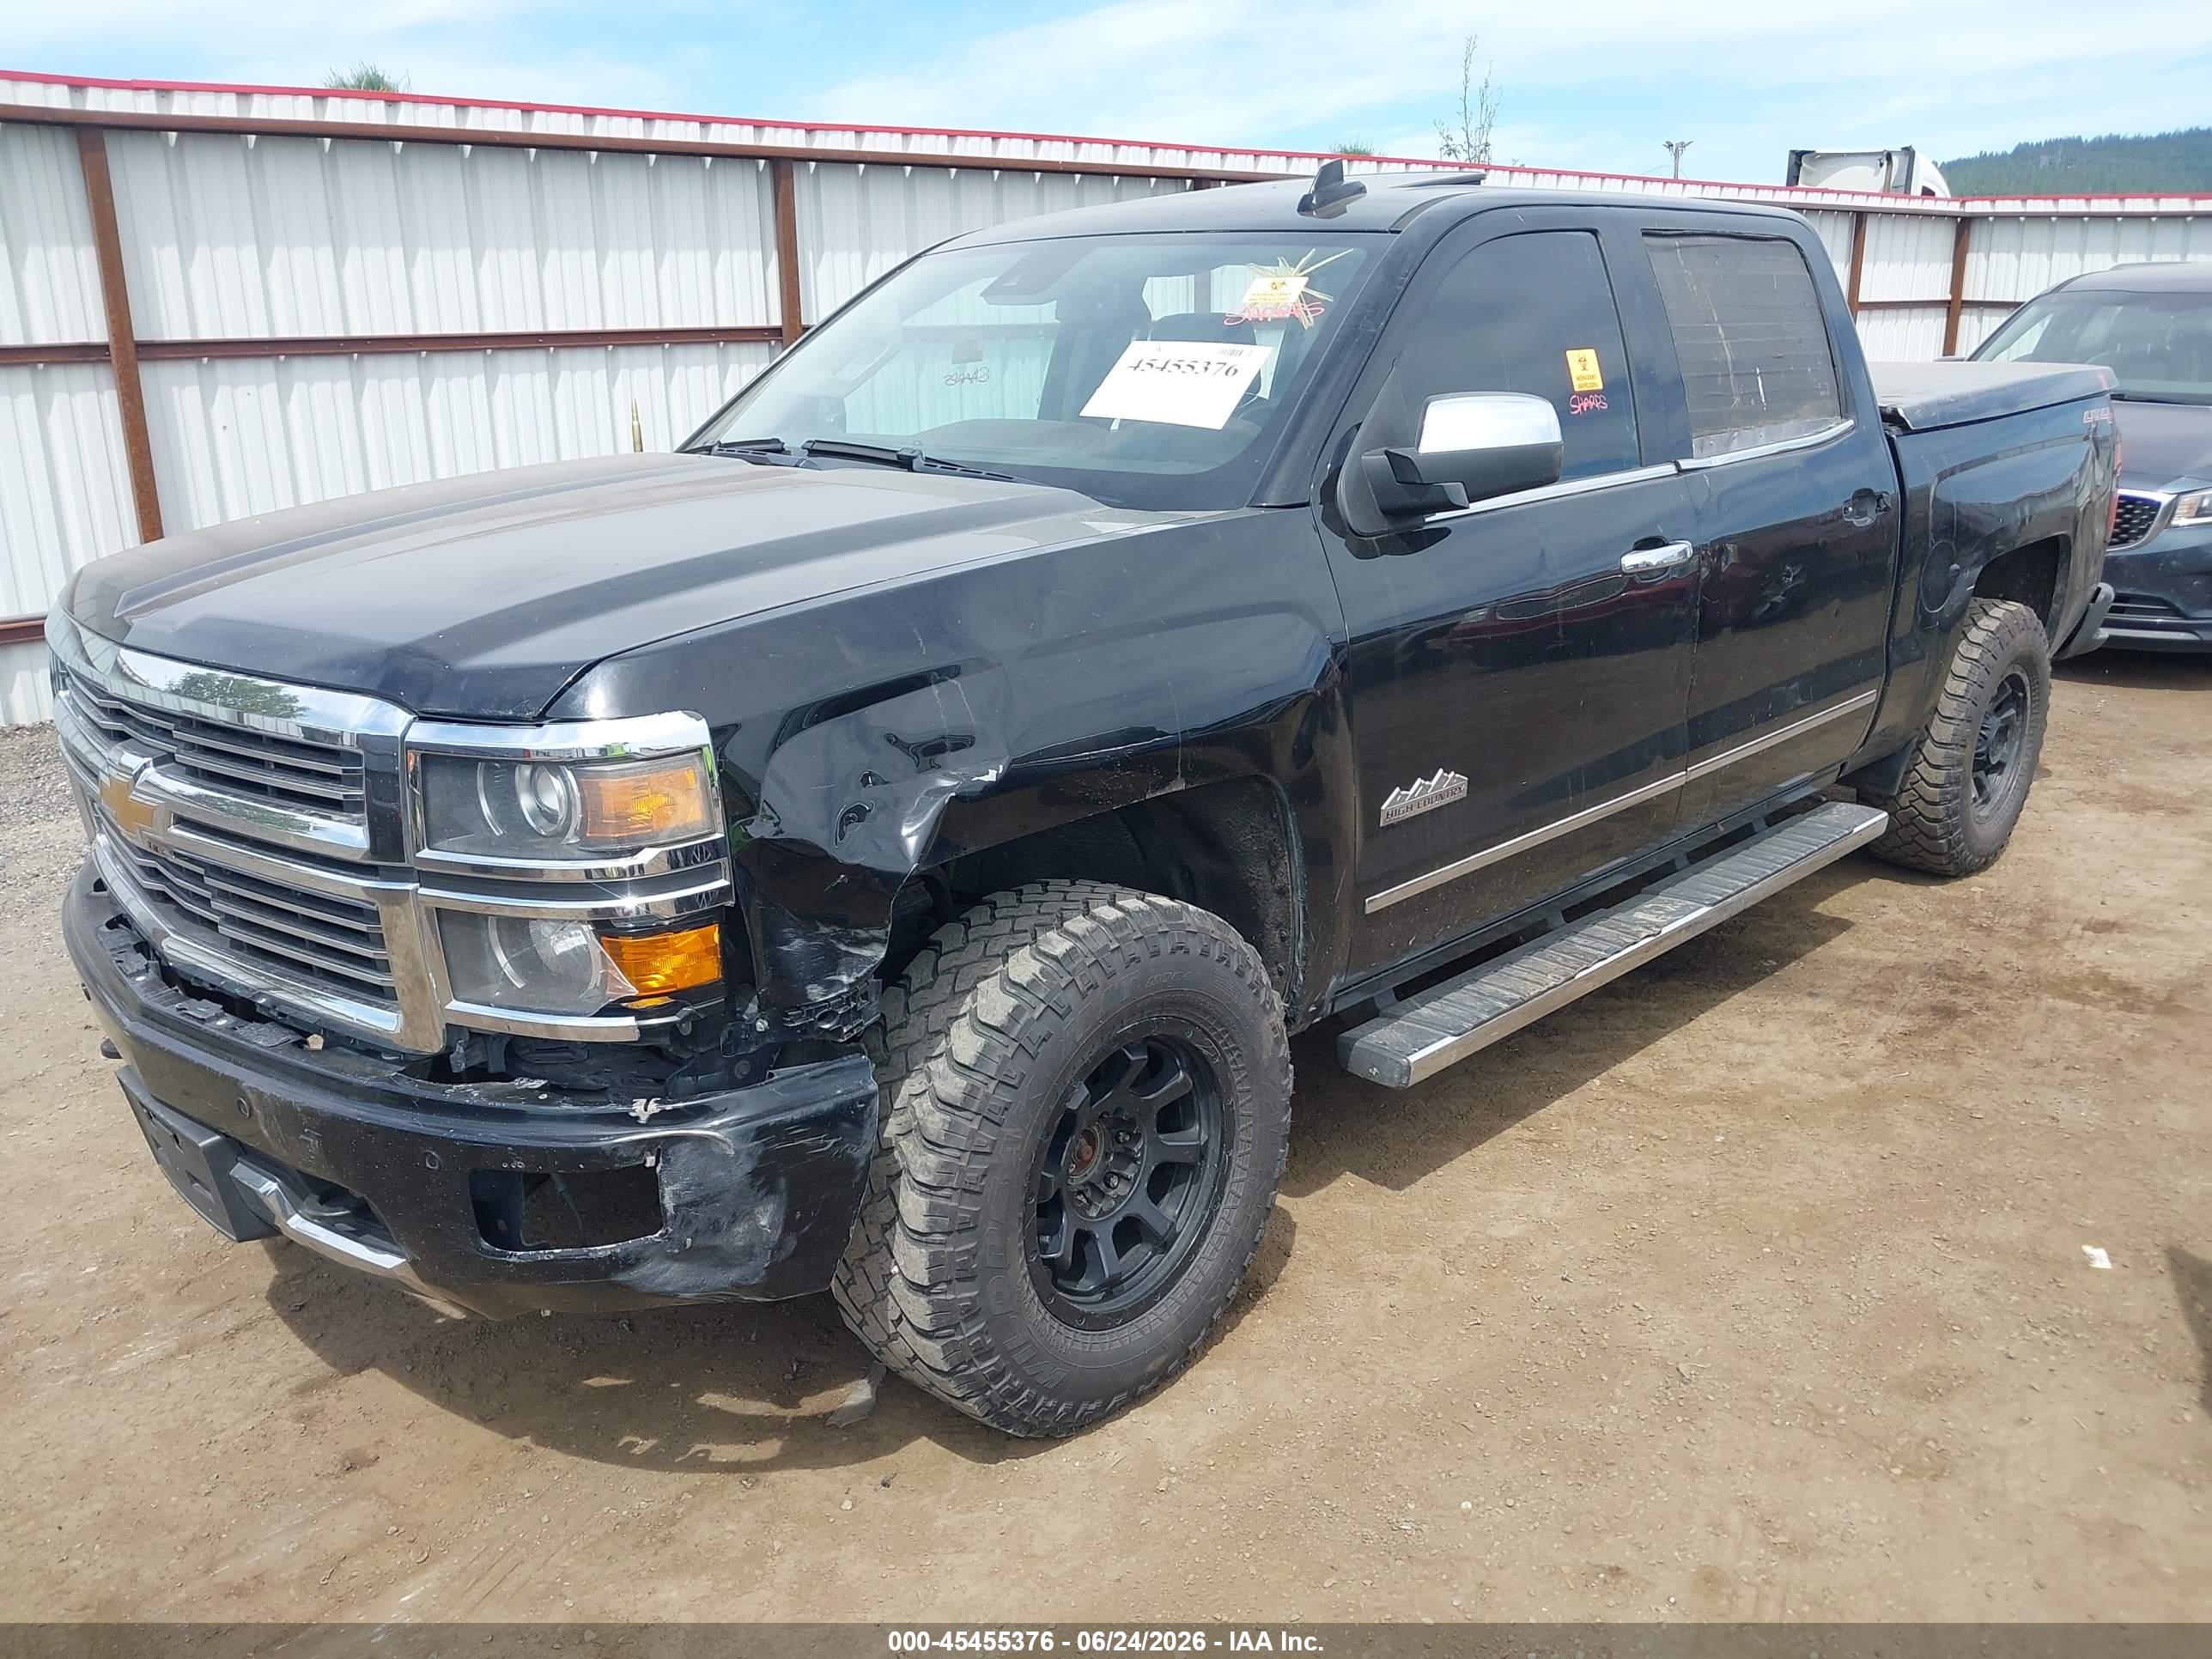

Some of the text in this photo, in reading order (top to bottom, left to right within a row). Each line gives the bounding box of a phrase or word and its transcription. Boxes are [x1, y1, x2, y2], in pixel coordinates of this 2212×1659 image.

[1128, 358, 1238, 377] 45455376
[1570, 394, 1608, 416] SHARPS
[1385, 787, 1465, 820] HIGH COUNTRY
